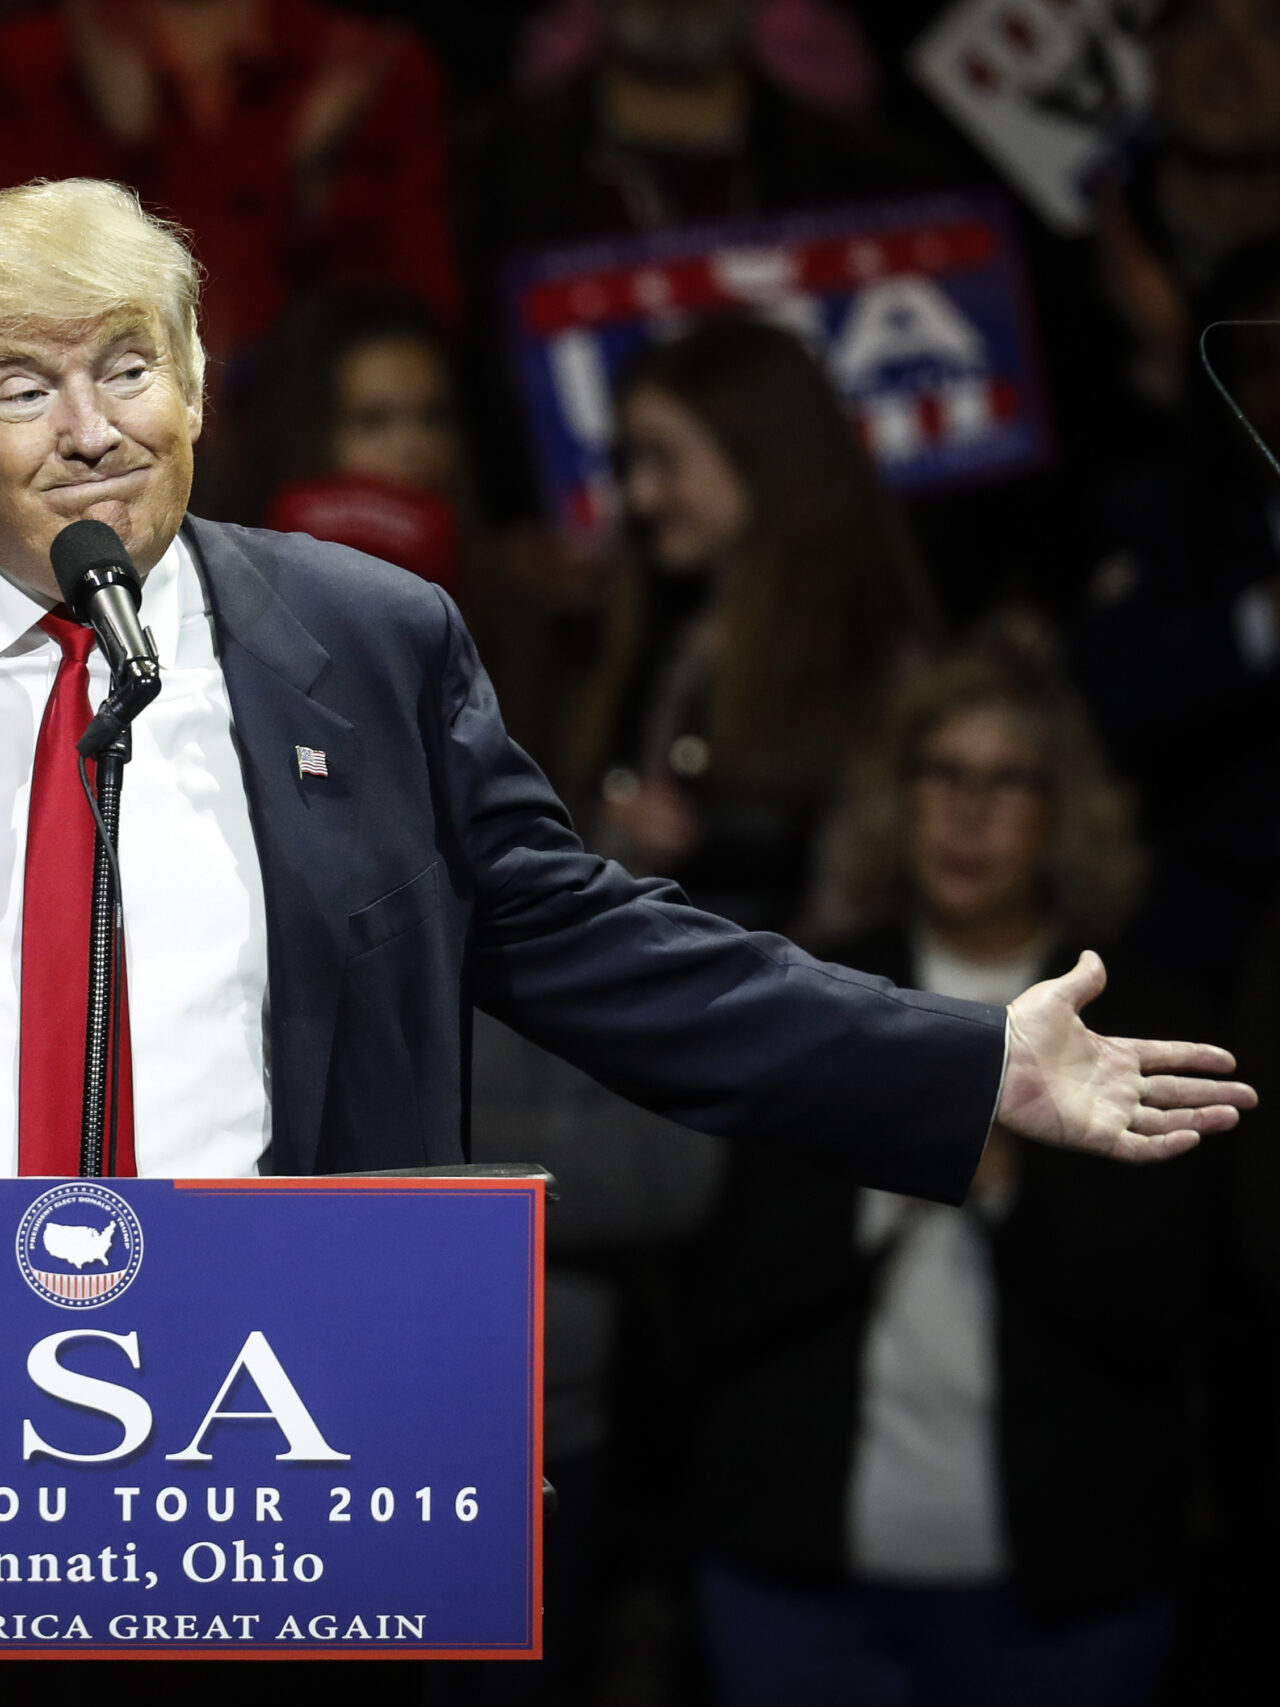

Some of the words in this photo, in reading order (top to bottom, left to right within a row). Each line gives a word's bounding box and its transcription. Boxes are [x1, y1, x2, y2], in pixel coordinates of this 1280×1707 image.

[29, 1206, 54, 1250] PRESIDENT
[54, 1197, 77, 1208] ELECT
[78, 1196, 111, 1212] DONALD
[116, 1217, 130, 1250] TRUMP
[114, 1486, 283, 1523] TOUR
[328, 1486, 479, 1523] 2016
[182, 1539, 324, 1583] Ohio
[108, 1614, 260, 1640] GREAT
[274, 1614, 427, 1640] AGAIN
